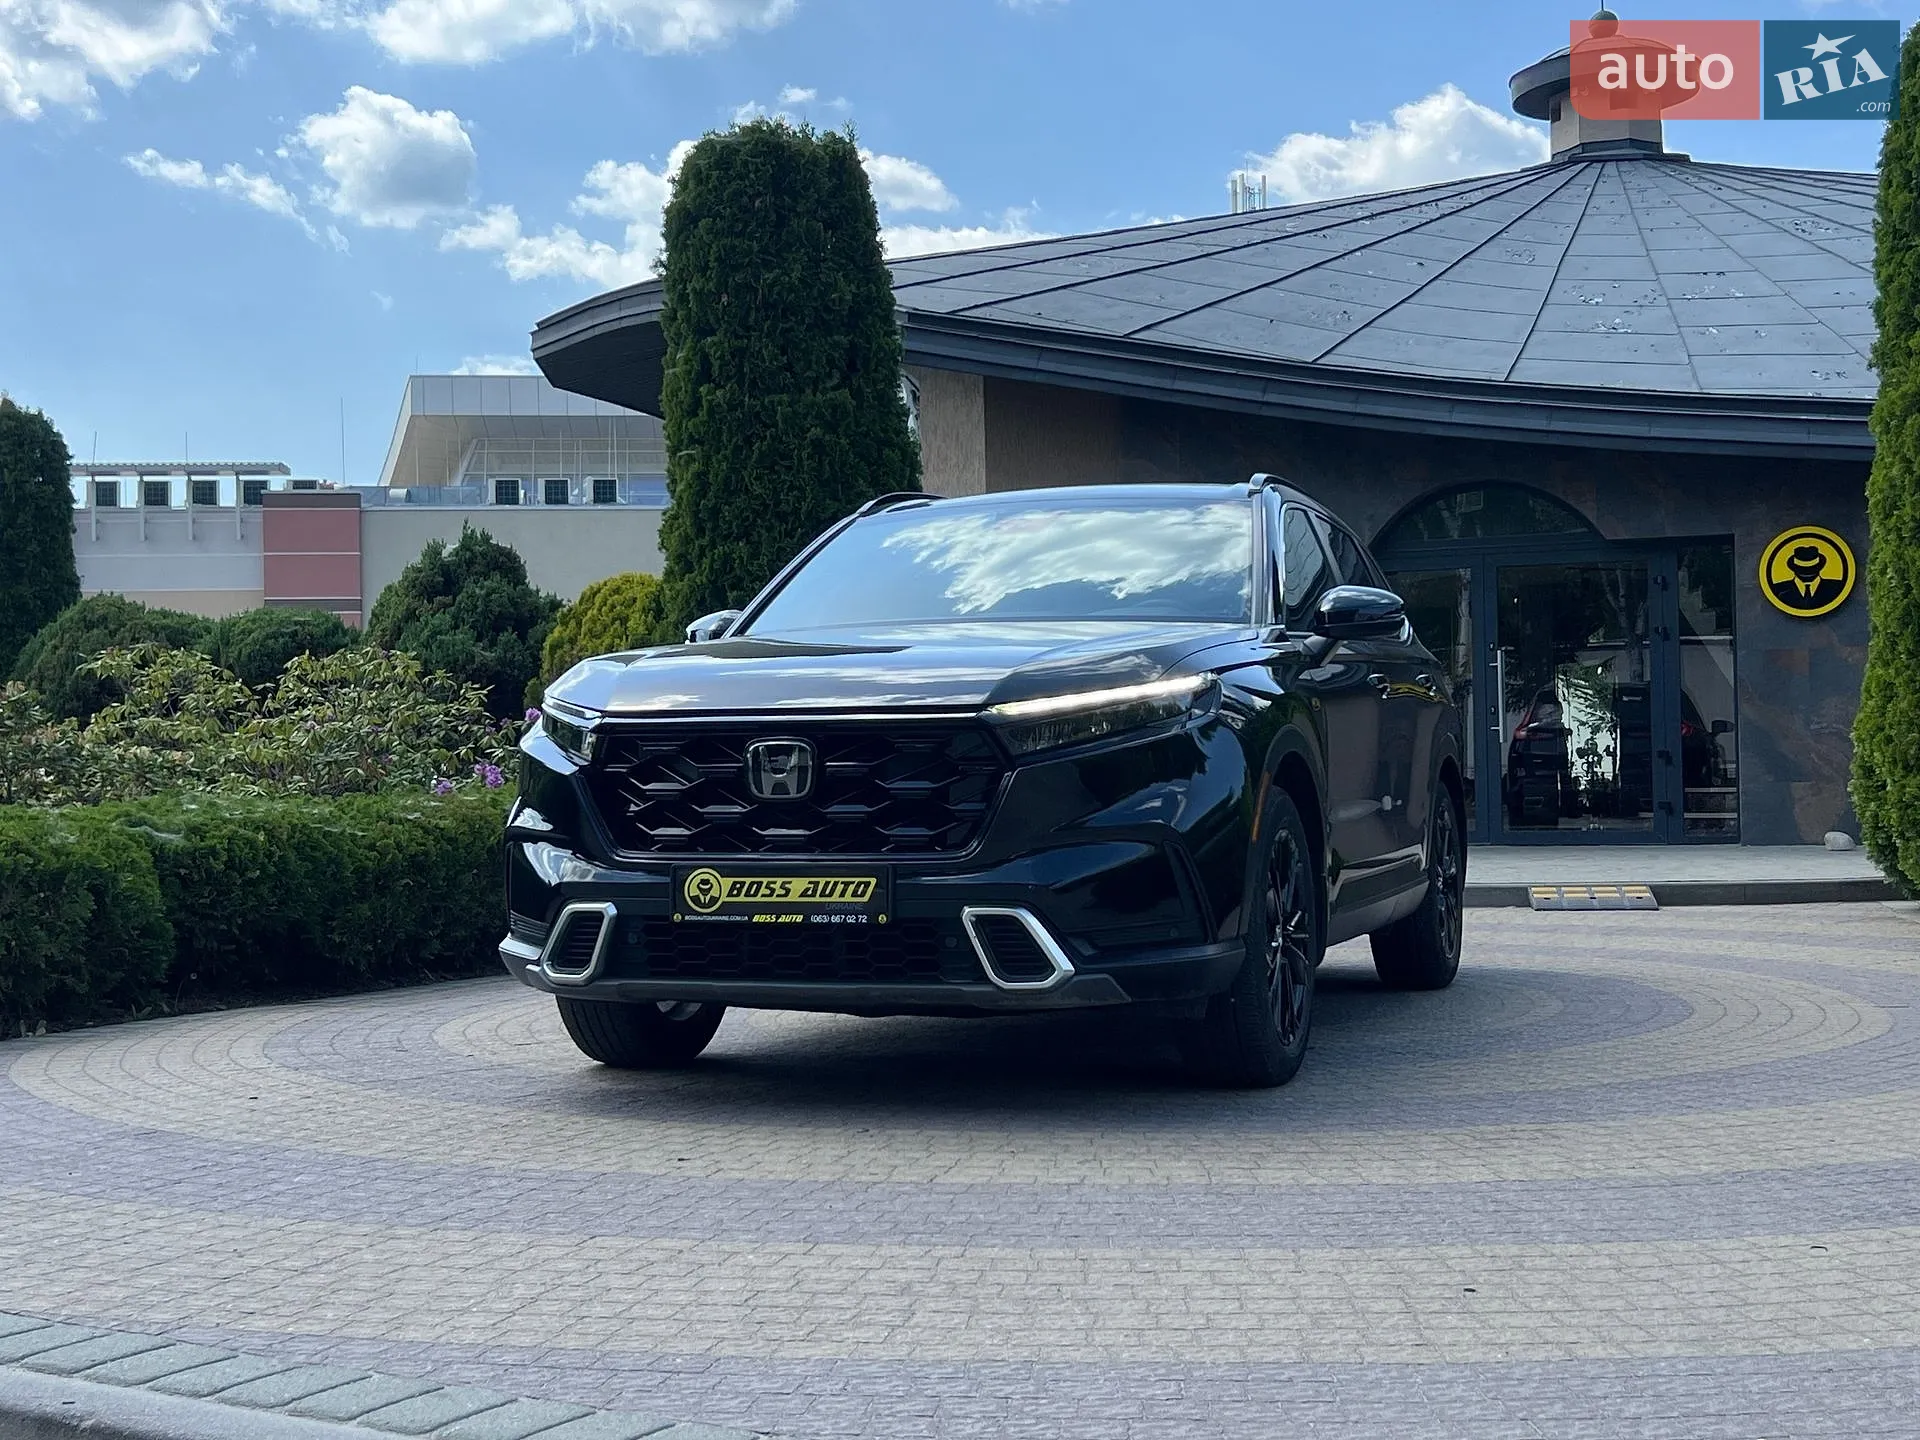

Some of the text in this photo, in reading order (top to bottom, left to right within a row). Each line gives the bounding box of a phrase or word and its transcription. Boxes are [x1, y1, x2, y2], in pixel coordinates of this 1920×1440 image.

[726, 881, 872, 898] BOSS AUTO
[752, 914, 804, 922] BOSS AUTO
[810, 914, 867, 923] (063) 667 02 72
